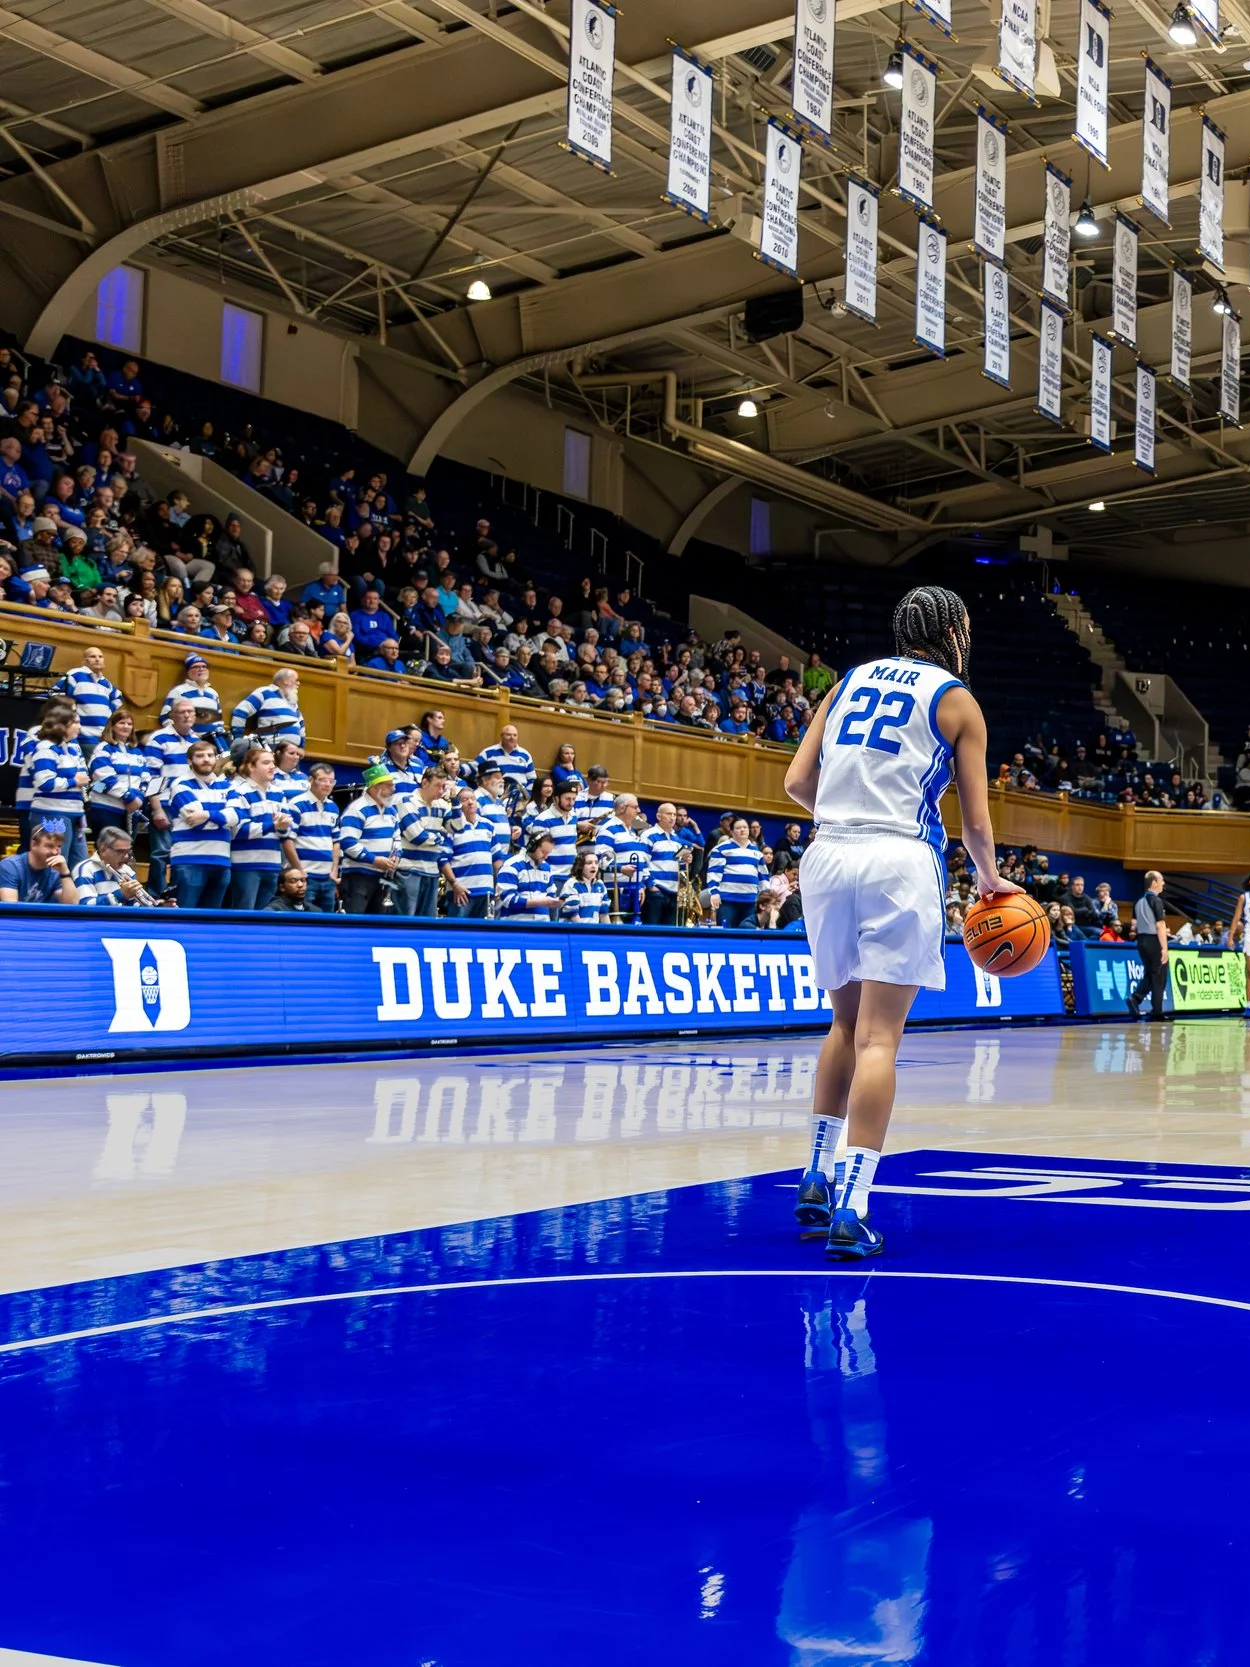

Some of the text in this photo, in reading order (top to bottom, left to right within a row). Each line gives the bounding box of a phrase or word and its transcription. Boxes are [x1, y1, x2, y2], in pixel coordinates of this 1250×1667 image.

[1013, 2, 1028, 24] NCAA
[804, 25, 827, 52] ATLANTIC
[806, 42, 824, 62] COAST
[579, 55, 606, 81] ATLANTIC
[797, 49, 831, 83] CONFERENCE
[582, 71, 603, 91] COAST
[798, 64, 830, 96] CHAMPIONS
[573, 79, 612, 111] CONFERENCE
[574, 94, 610, 125] CHAMPIONS
[907, 109, 930, 133] ATLANTIC
[678, 113, 705, 138] ATLANTIC
[671, 136, 708, 164] CONFERENCE
[684, 129, 701, 150] COAST
[903, 132, 934, 161] CONFERENCE
[672, 151, 707, 178] CHAMPIONS
[904, 144, 932, 172] CHAMPIONS
[982, 170, 1002, 191] ATLANTIC
[978, 191, 1006, 217] CONFERENCE
[772, 242, 789, 259] 2010
[868, 665, 921, 687] MAIR
[835, 687, 916, 755] 22
[965, 914, 1005, 945] ELITE
[372, 945, 834, 1021] DUKE BASKETB
[1127, 960, 1144, 981] Nor
